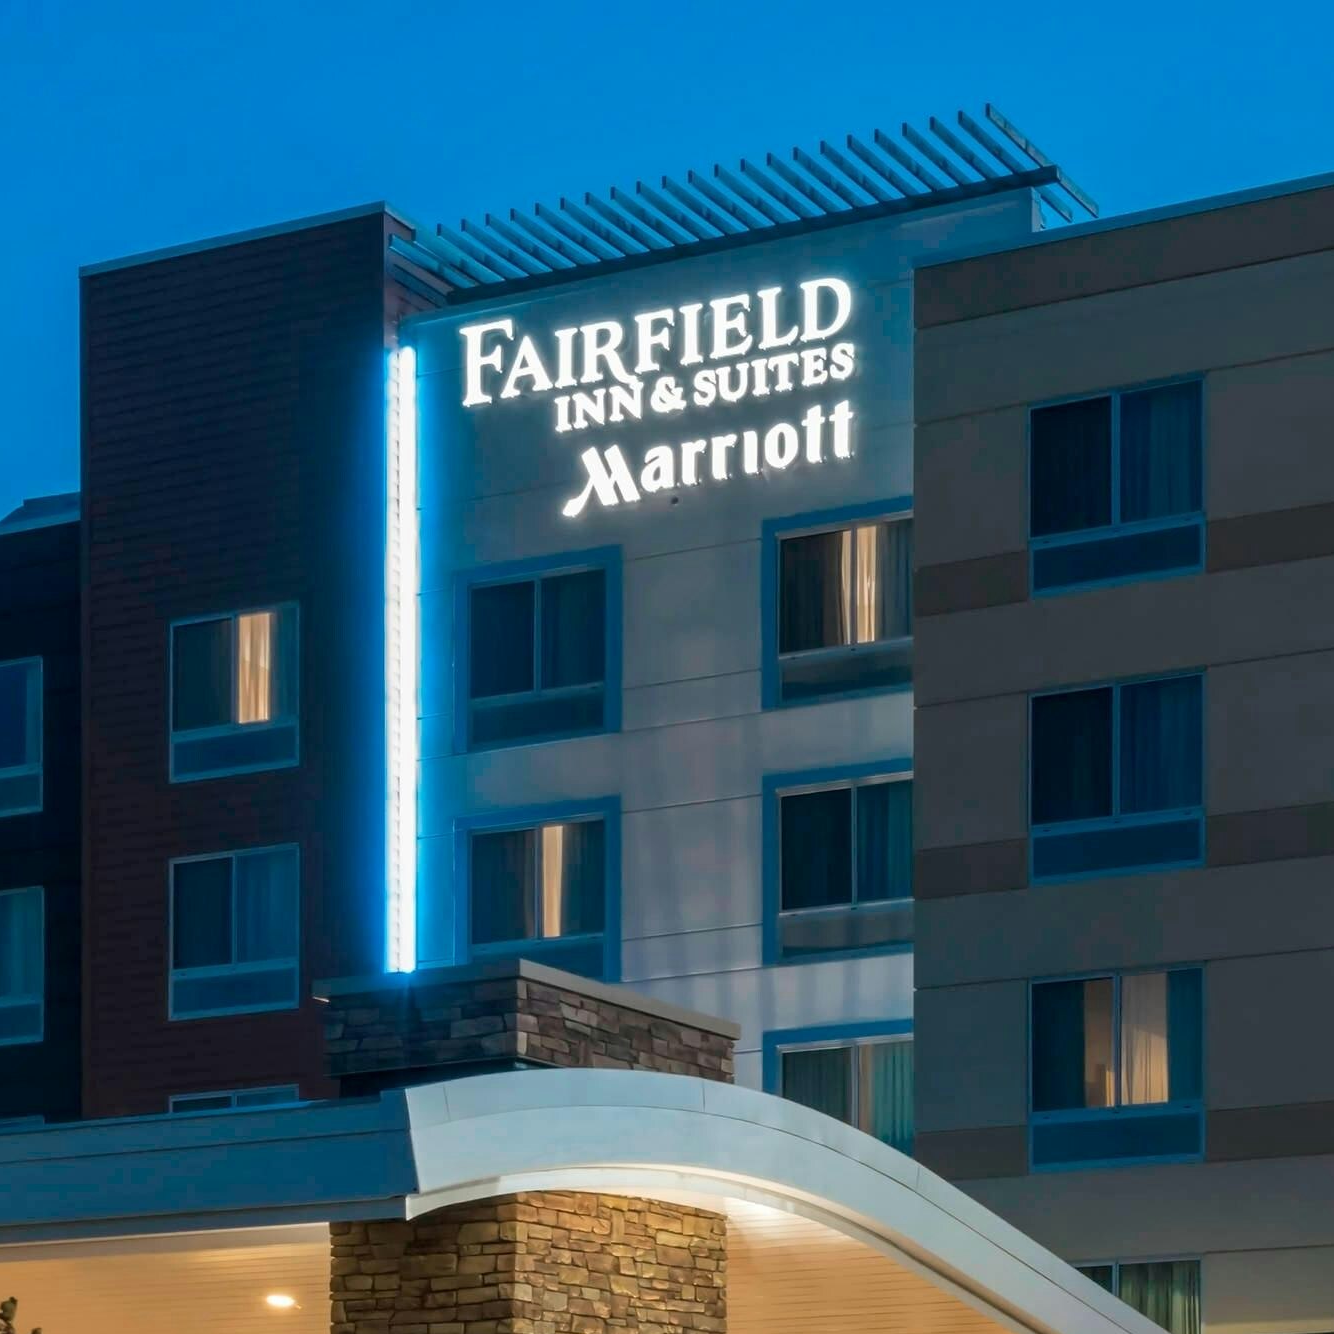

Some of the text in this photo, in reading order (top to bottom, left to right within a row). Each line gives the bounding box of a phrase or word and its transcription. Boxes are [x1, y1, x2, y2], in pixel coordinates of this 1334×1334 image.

[460, 277, 853, 407] FAIRFIELD
[554, 342, 856, 433] INN & SUITES
[561, 400, 856, 517] Marriott
